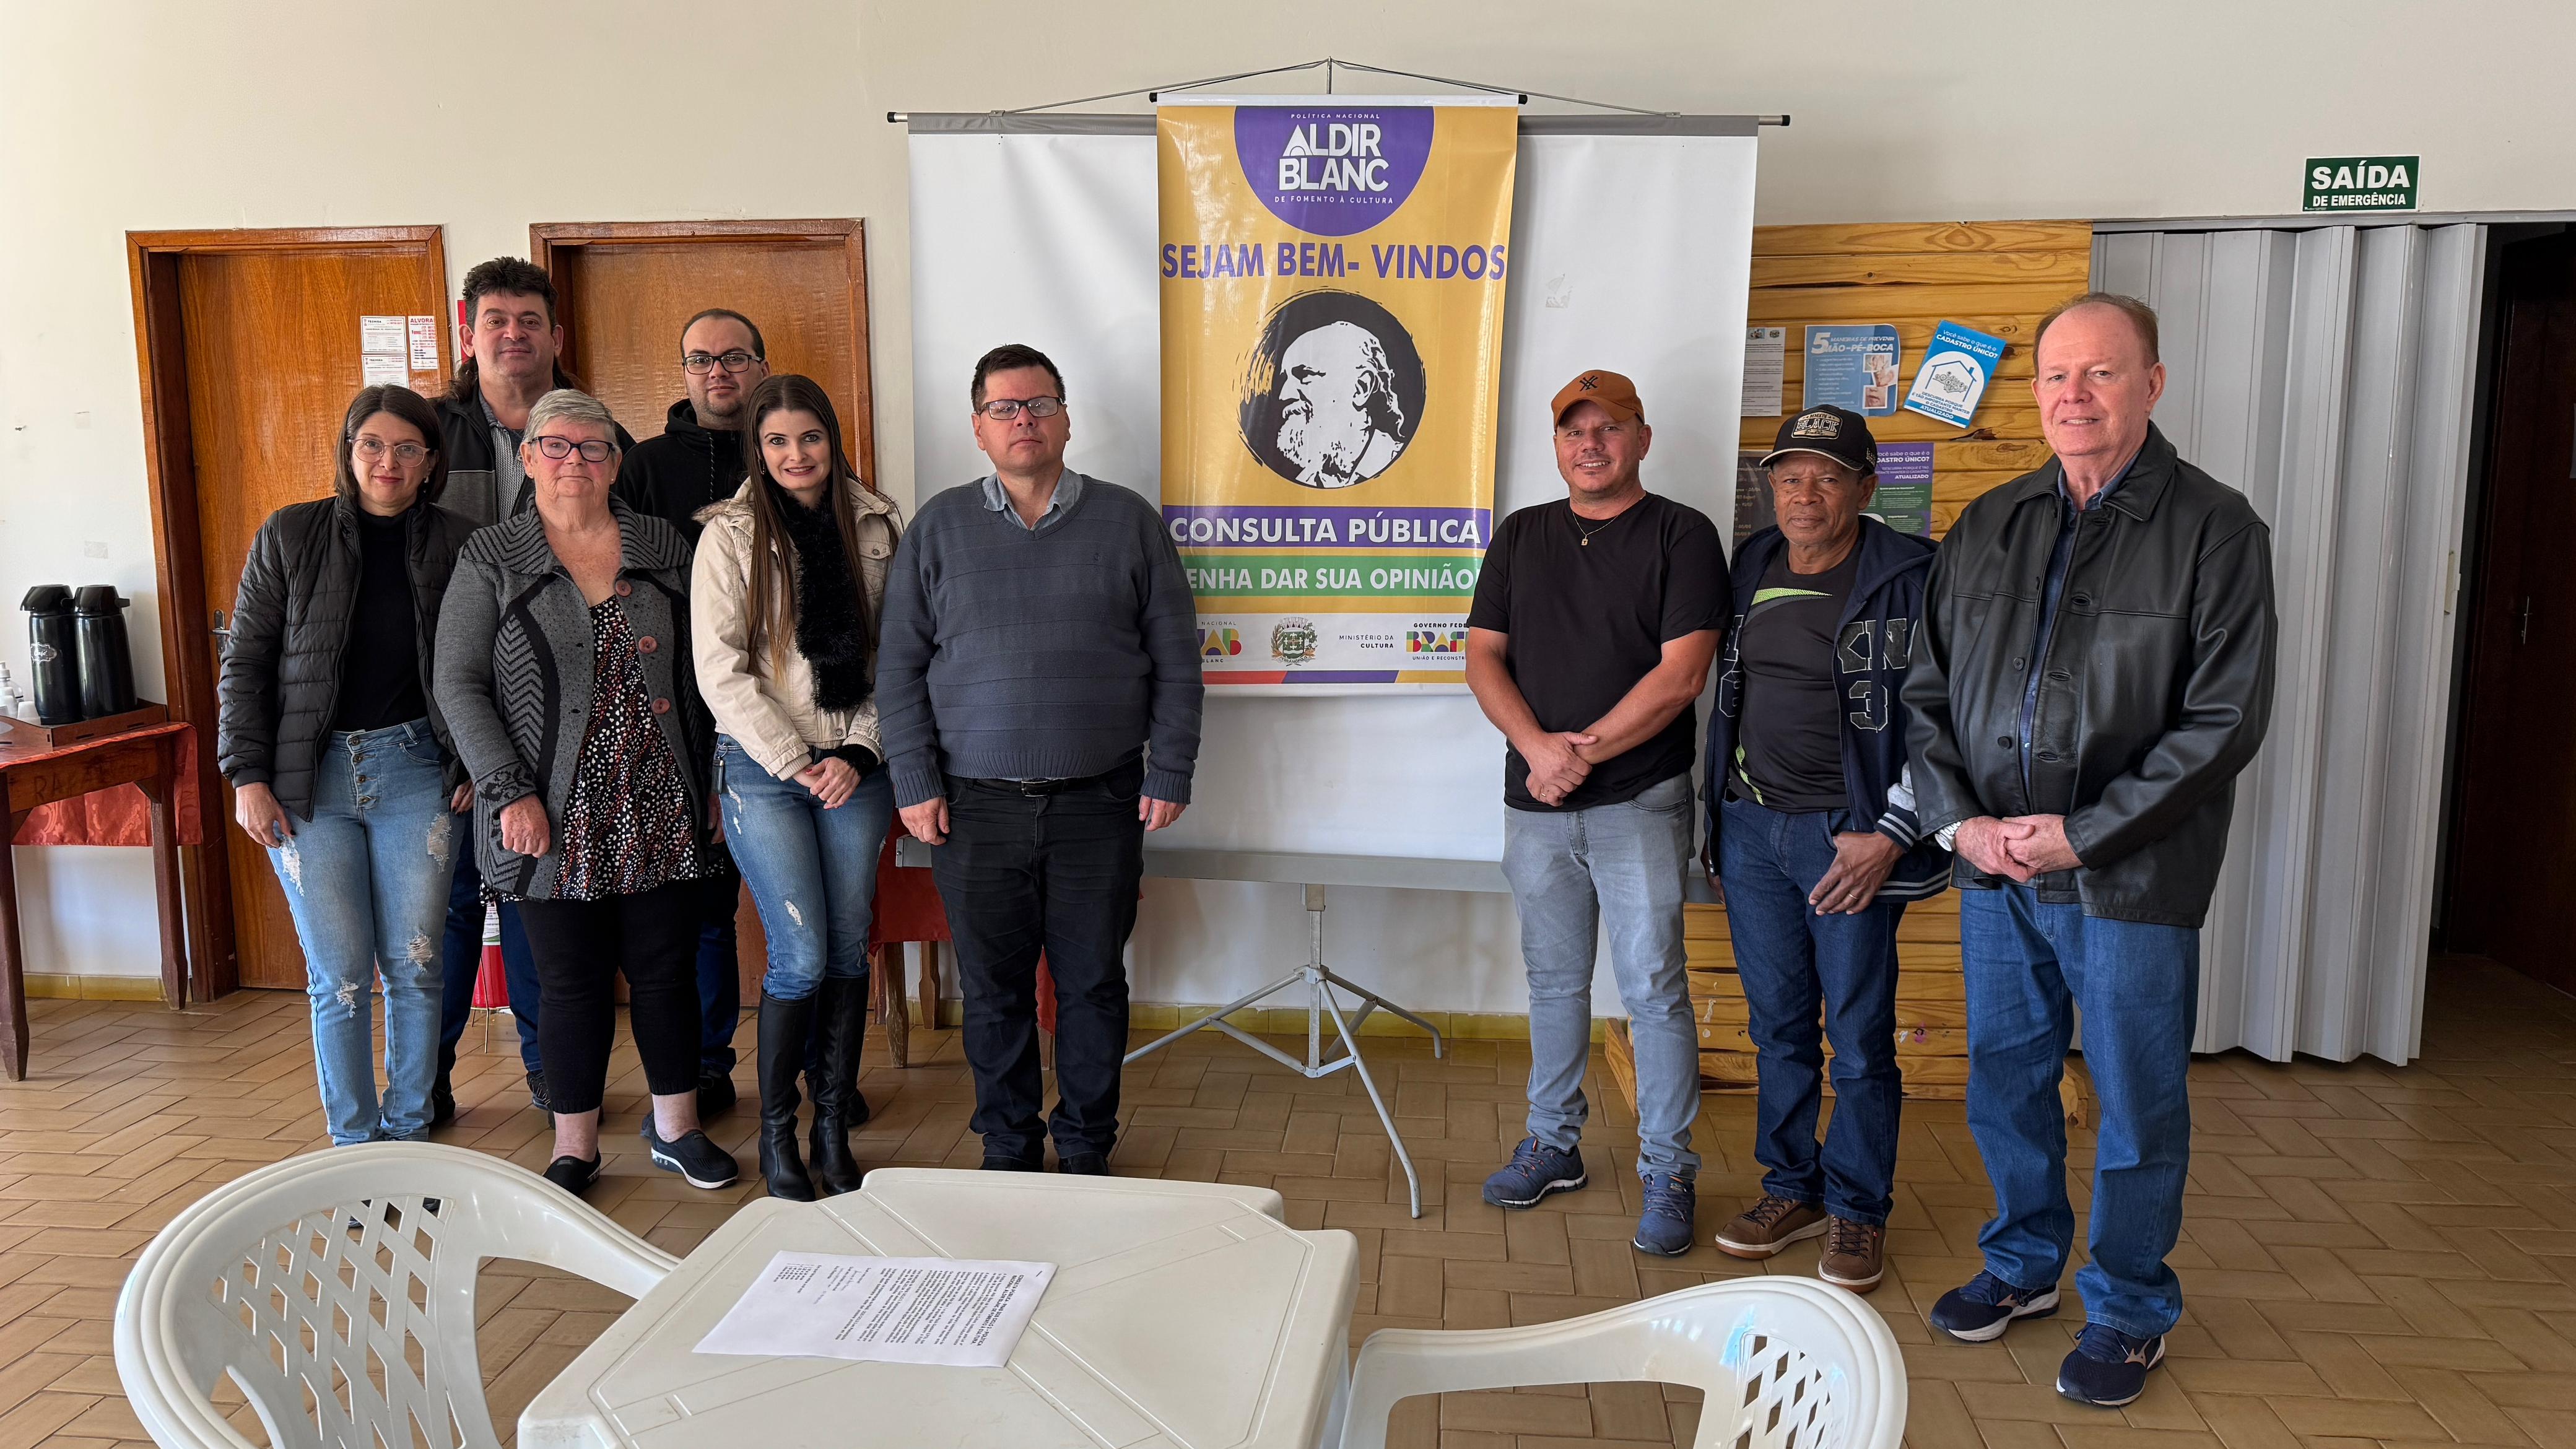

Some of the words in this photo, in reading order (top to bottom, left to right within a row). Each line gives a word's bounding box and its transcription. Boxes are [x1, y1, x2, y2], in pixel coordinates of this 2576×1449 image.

[1282, 123, 1382, 157] ALDIR
[1279, 157, 1390, 192] BLANC
[2311, 160, 2411, 190] SAÍDA
[1290, 195, 1334, 203] FOMENTO
[1339, 194, 1345, 203] À
[2312, 195, 2328, 207] DE
[2331, 192, 2406, 206] EMERGÊNCIA
[1162, 243, 1265, 279] SEJAM
[1277, 242, 1360, 277] BEM-
[1371, 244, 1505, 280] VINDOS
[1811, 332, 1831, 354] 5
[1943, 330, 1957, 338] Você
[1936, 334, 1972, 350] CADASTRO
[1972, 345, 1998, 359] ÚNICO?
[1920, 405, 1954, 419] ATUALIZADO
[1795, 417, 1840, 433] BLACK
[1169, 517, 1338, 543] CONSULTA
[1349, 511, 1481, 544] PÚBLICA
[1187, 568, 1253, 590] ENHA
[1261, 568, 1308, 590] DAR
[1315, 568, 1363, 590] SUA
